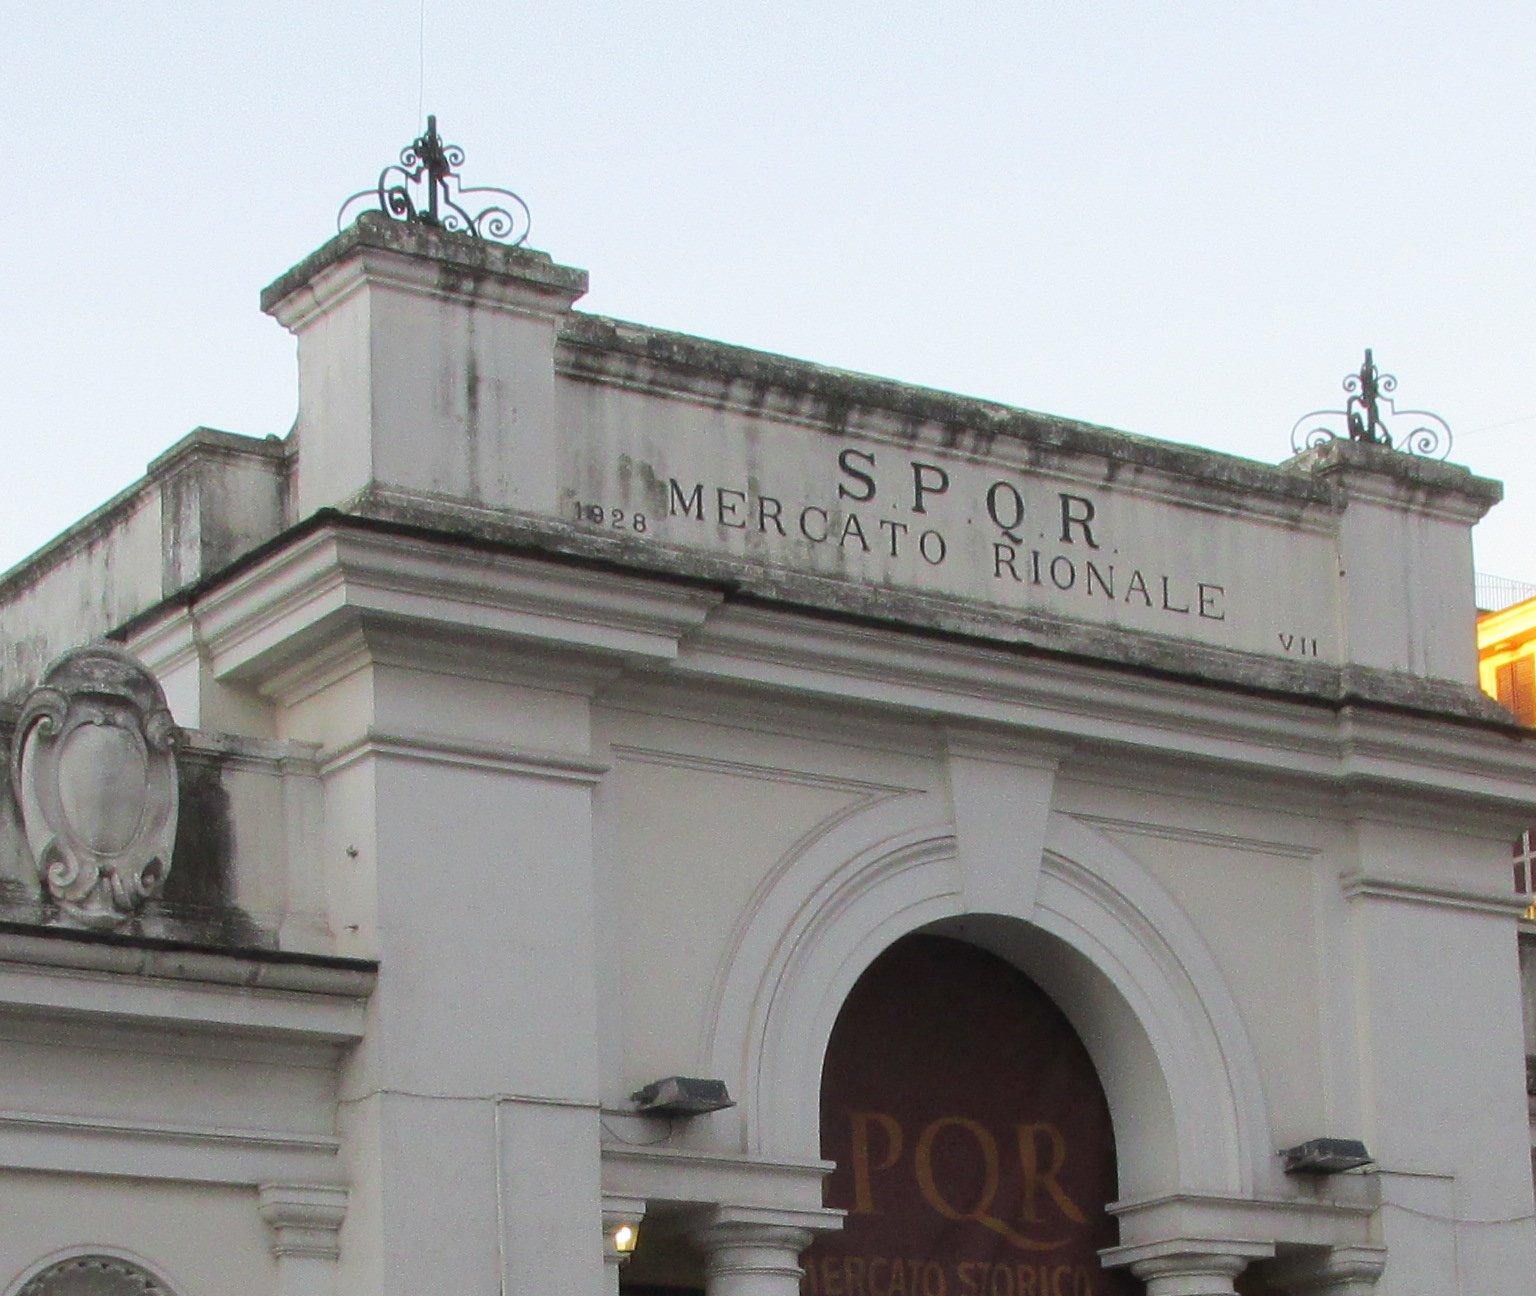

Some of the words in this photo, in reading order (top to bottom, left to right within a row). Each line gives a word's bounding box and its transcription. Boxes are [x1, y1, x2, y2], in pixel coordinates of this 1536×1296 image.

[575, 501, 648, 534] 1928
[669, 477, 948, 566] MERCATO
[993, 542, 1226, 621] RIONALE
[1278, 632, 1318, 657] VII
[822, 1112, 1088, 1250] PQR
